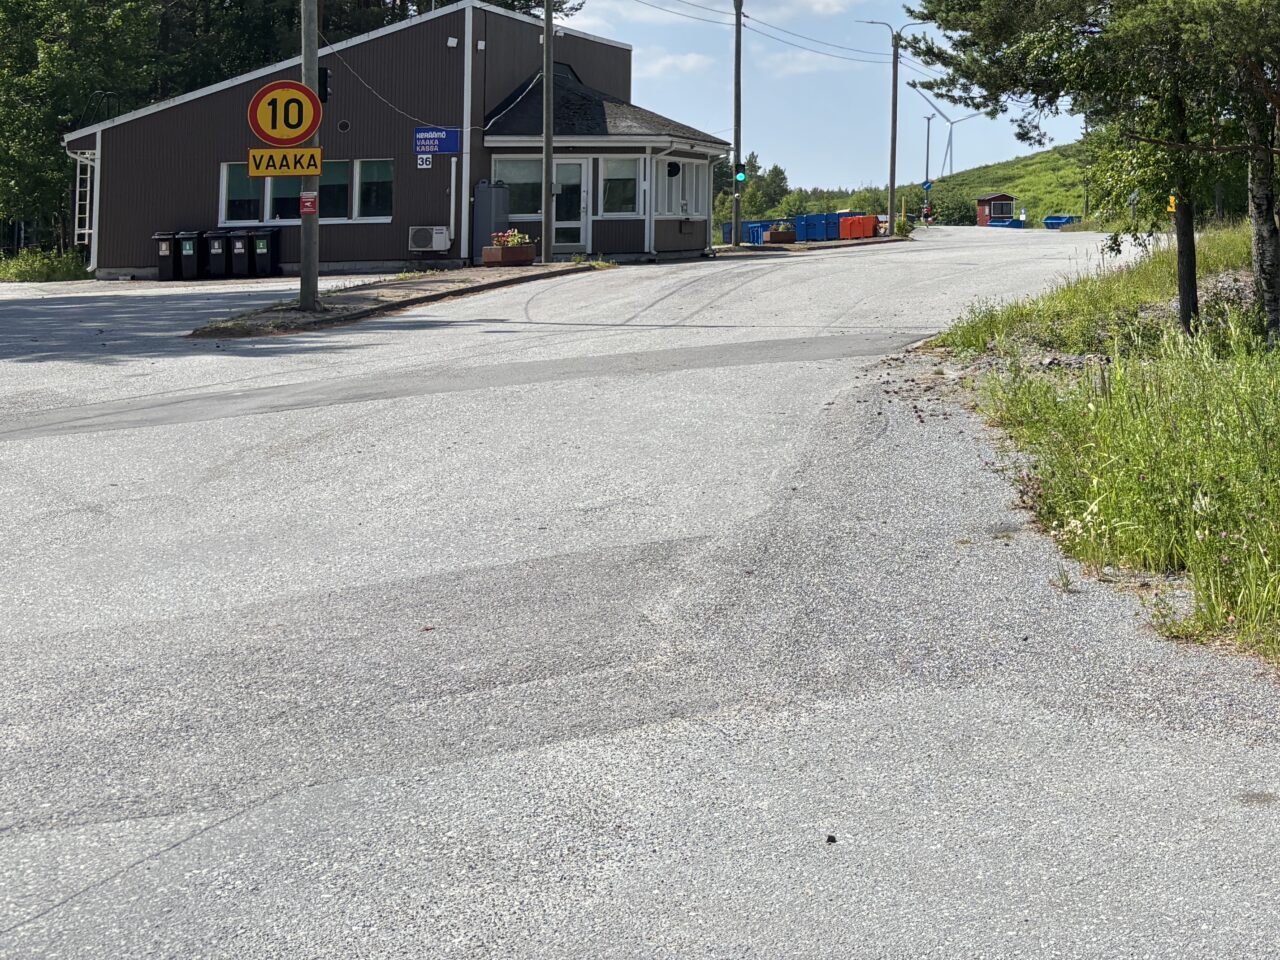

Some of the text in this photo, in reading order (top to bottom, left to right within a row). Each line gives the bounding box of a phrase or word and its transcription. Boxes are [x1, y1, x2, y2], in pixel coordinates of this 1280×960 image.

[267, 98, 304, 130] 10
[252, 154, 318, 171] VAAKA
[418, 156, 432, 166] 36
